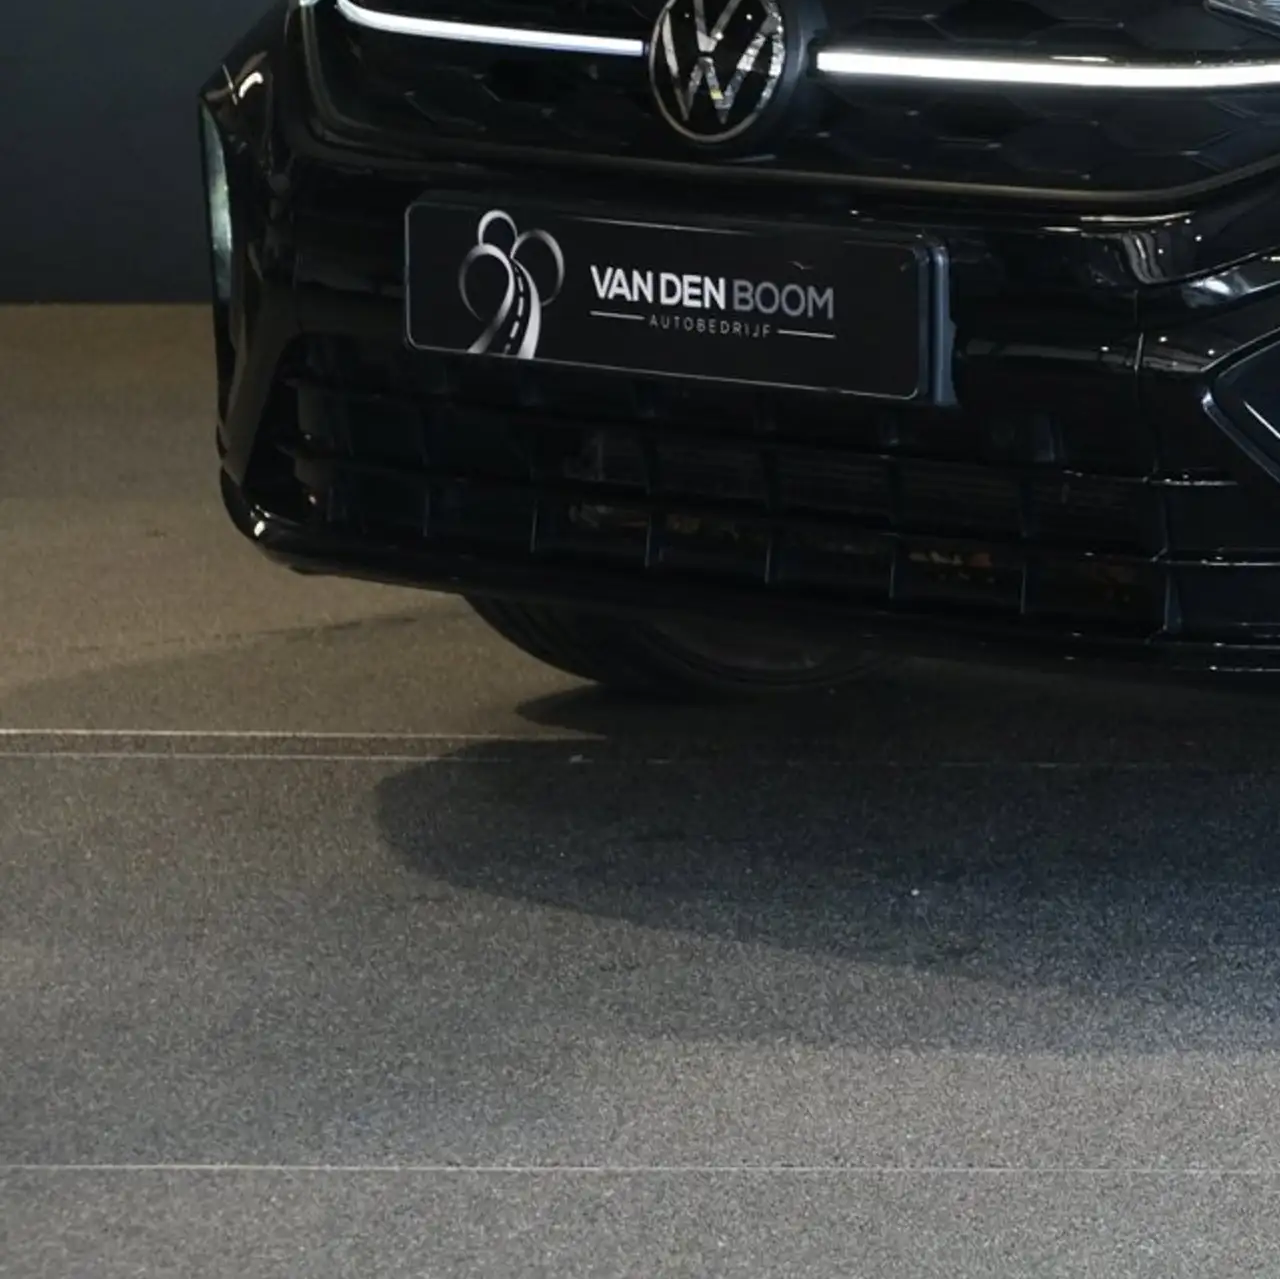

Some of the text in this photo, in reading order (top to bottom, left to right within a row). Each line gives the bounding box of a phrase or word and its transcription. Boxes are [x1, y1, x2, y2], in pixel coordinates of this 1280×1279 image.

[589, 264, 834, 320] VAN DEN BOOM
[648, 313, 772, 338] AUTOBEDRIJF
